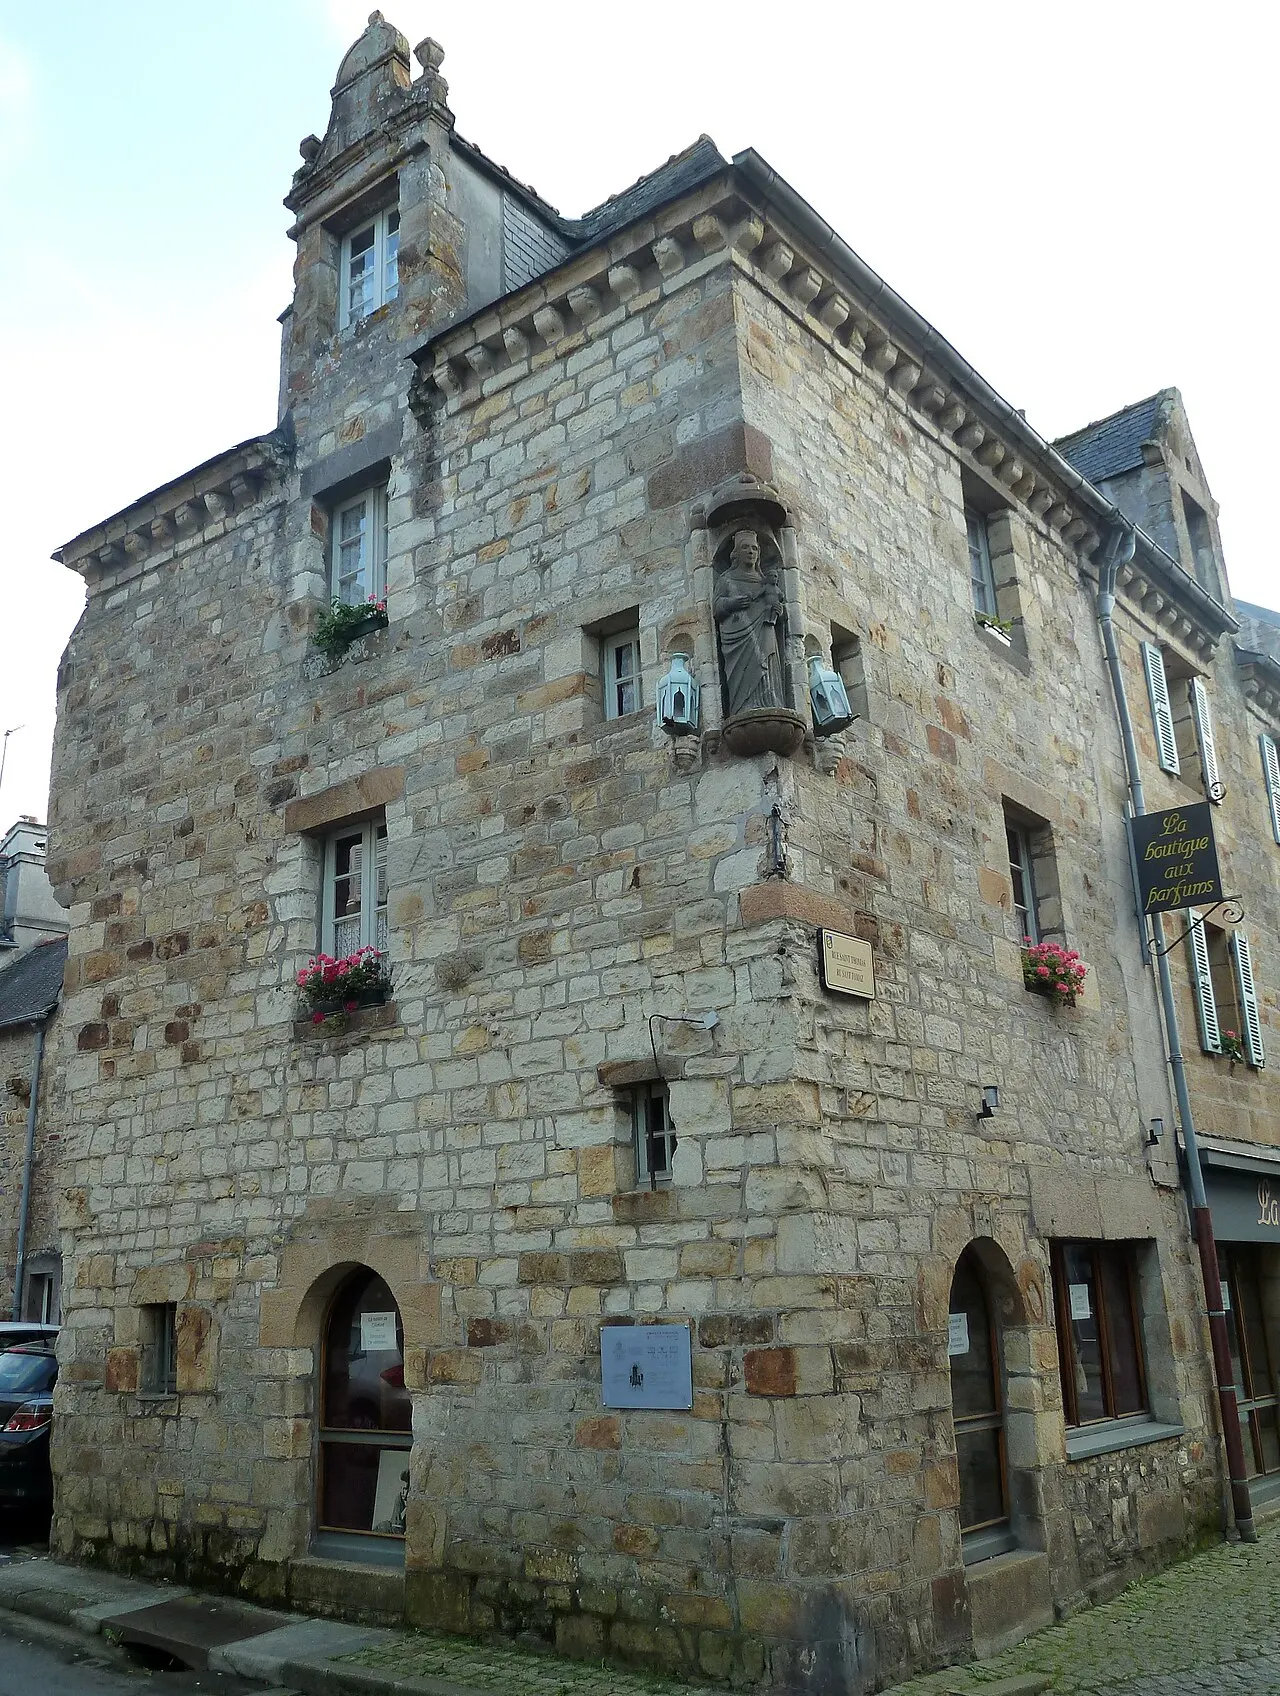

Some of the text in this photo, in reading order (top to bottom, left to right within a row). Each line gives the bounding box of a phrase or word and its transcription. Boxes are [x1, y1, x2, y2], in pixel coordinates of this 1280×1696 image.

[1159, 812, 1188, 837] La
[1144, 836, 1209, 861] boutique
[1164, 862, 1194, 879] aux
[1145, 879, 1214, 911] parfums
[1257, 1179, 1279, 1227] La
